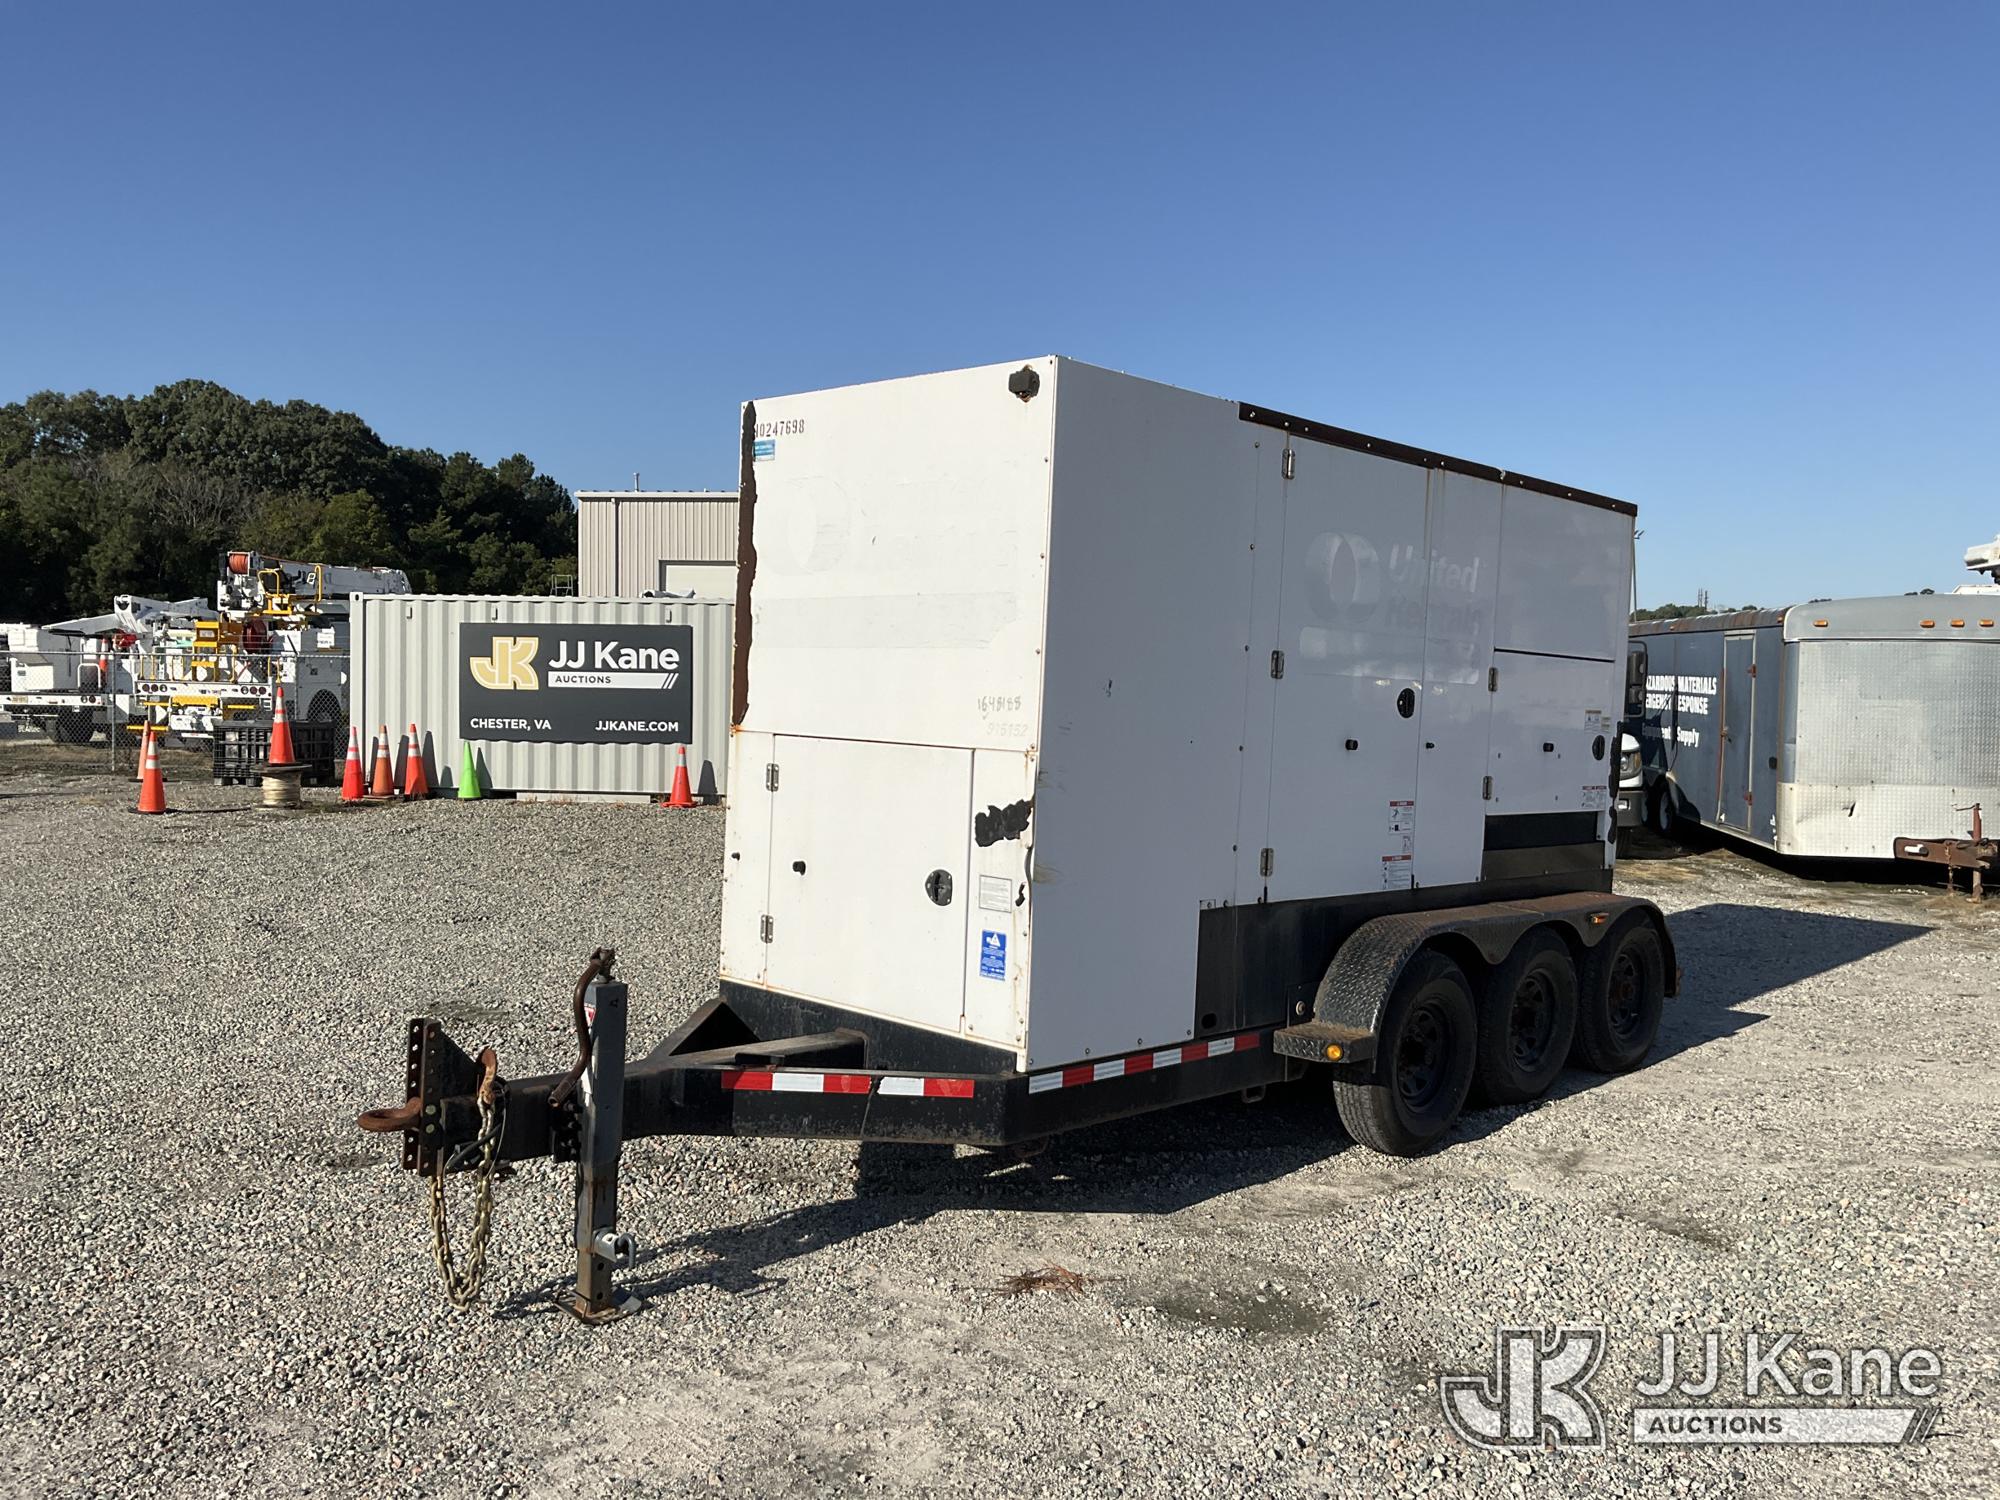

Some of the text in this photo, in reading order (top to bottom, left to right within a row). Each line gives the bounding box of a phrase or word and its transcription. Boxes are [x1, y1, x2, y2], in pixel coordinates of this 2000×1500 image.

[548, 640, 680, 670] JJ Kane
[554, 675, 612, 684] AUCTIONS
[1677, 676, 1717, 695] MATERIALS
[1677, 695, 1709, 715] ESPONSE
[470, 718, 552, 731] CHESTER, VA
[595, 720, 679, 732] JJKANE.COM
[1677, 726, 1700, 748] Supply
